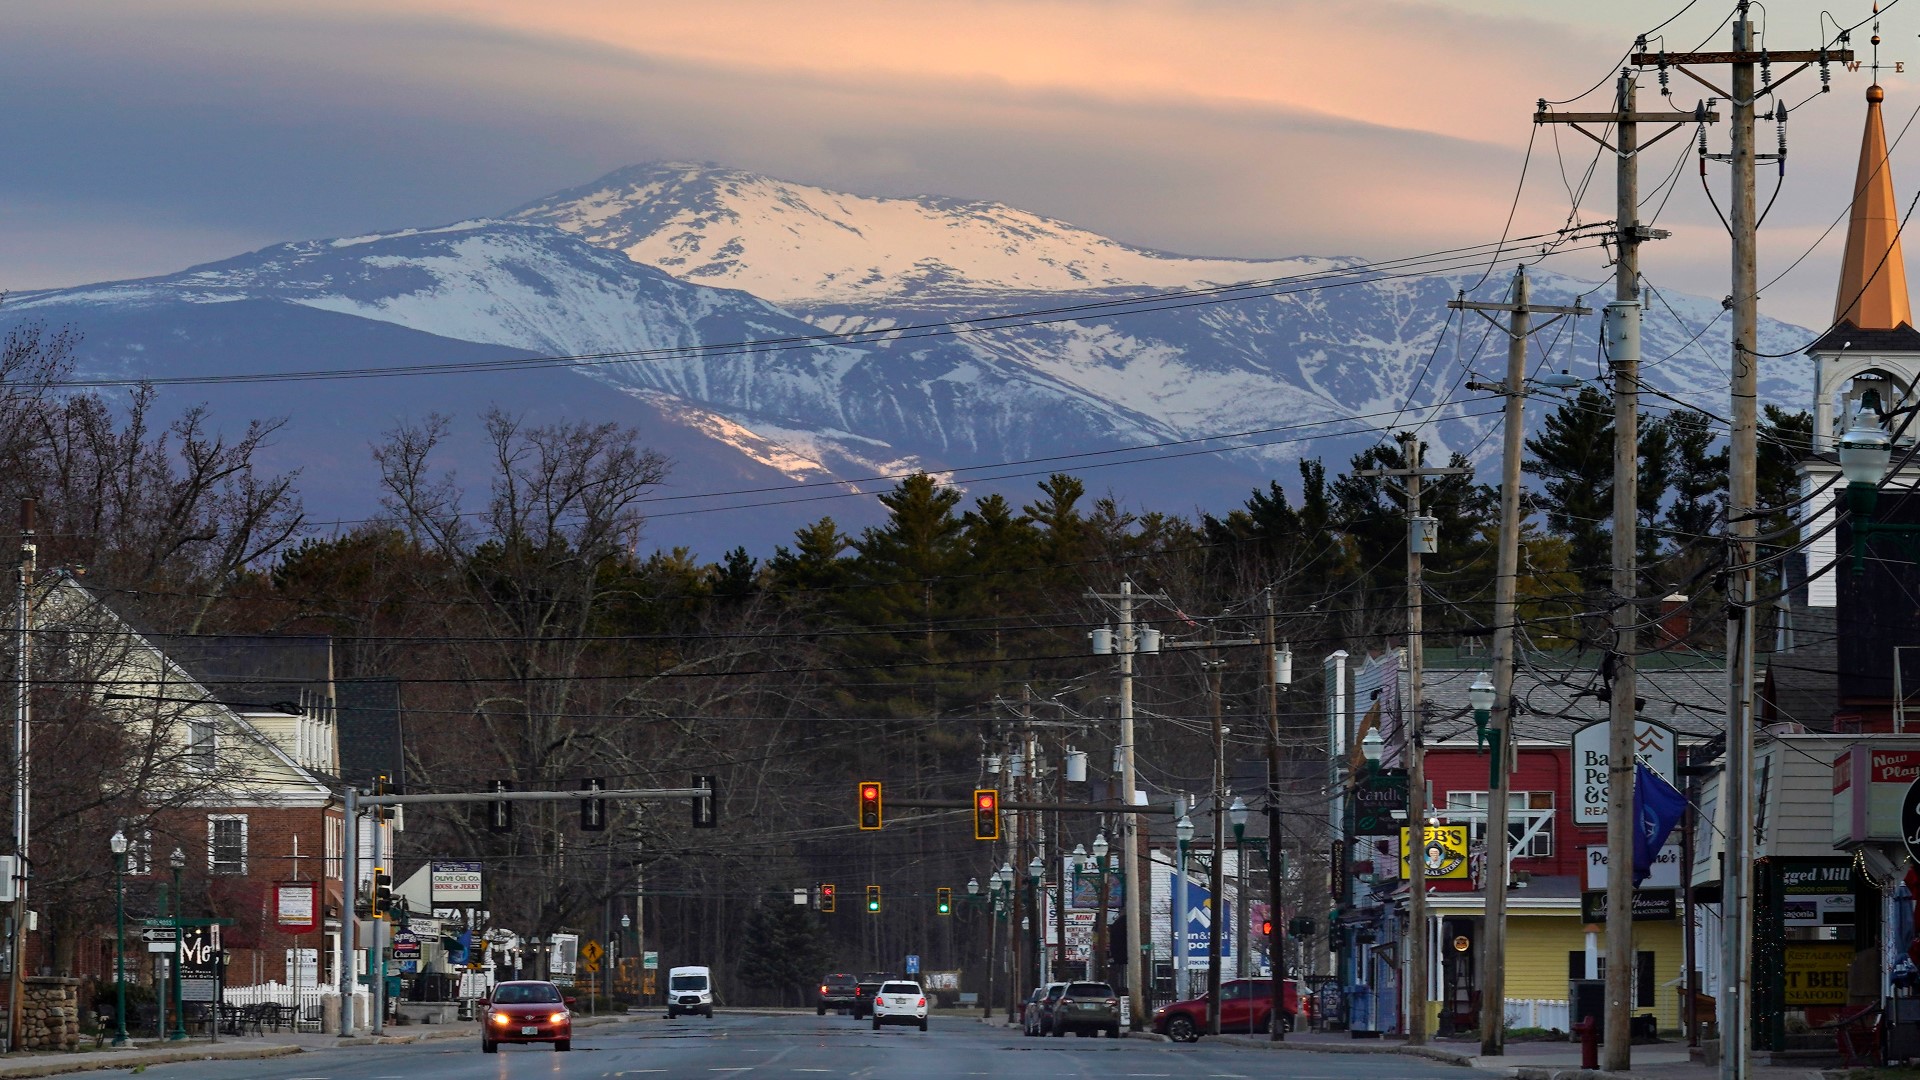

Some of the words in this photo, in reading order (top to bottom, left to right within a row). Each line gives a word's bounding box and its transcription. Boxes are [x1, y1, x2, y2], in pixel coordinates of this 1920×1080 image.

[1847, 62, 1862, 72] W
[1896, 62, 1904, 72] E
[1873, 755, 1907, 768] Now
[1882, 765, 1920, 780] Play
[1584, 807, 1608, 816] REA
[1406, 830, 1462, 846] EB'S
[1783, 868, 1817, 885] gged
[1820, 868, 1851, 880] Mill
[1199, 932, 1208, 940] &
